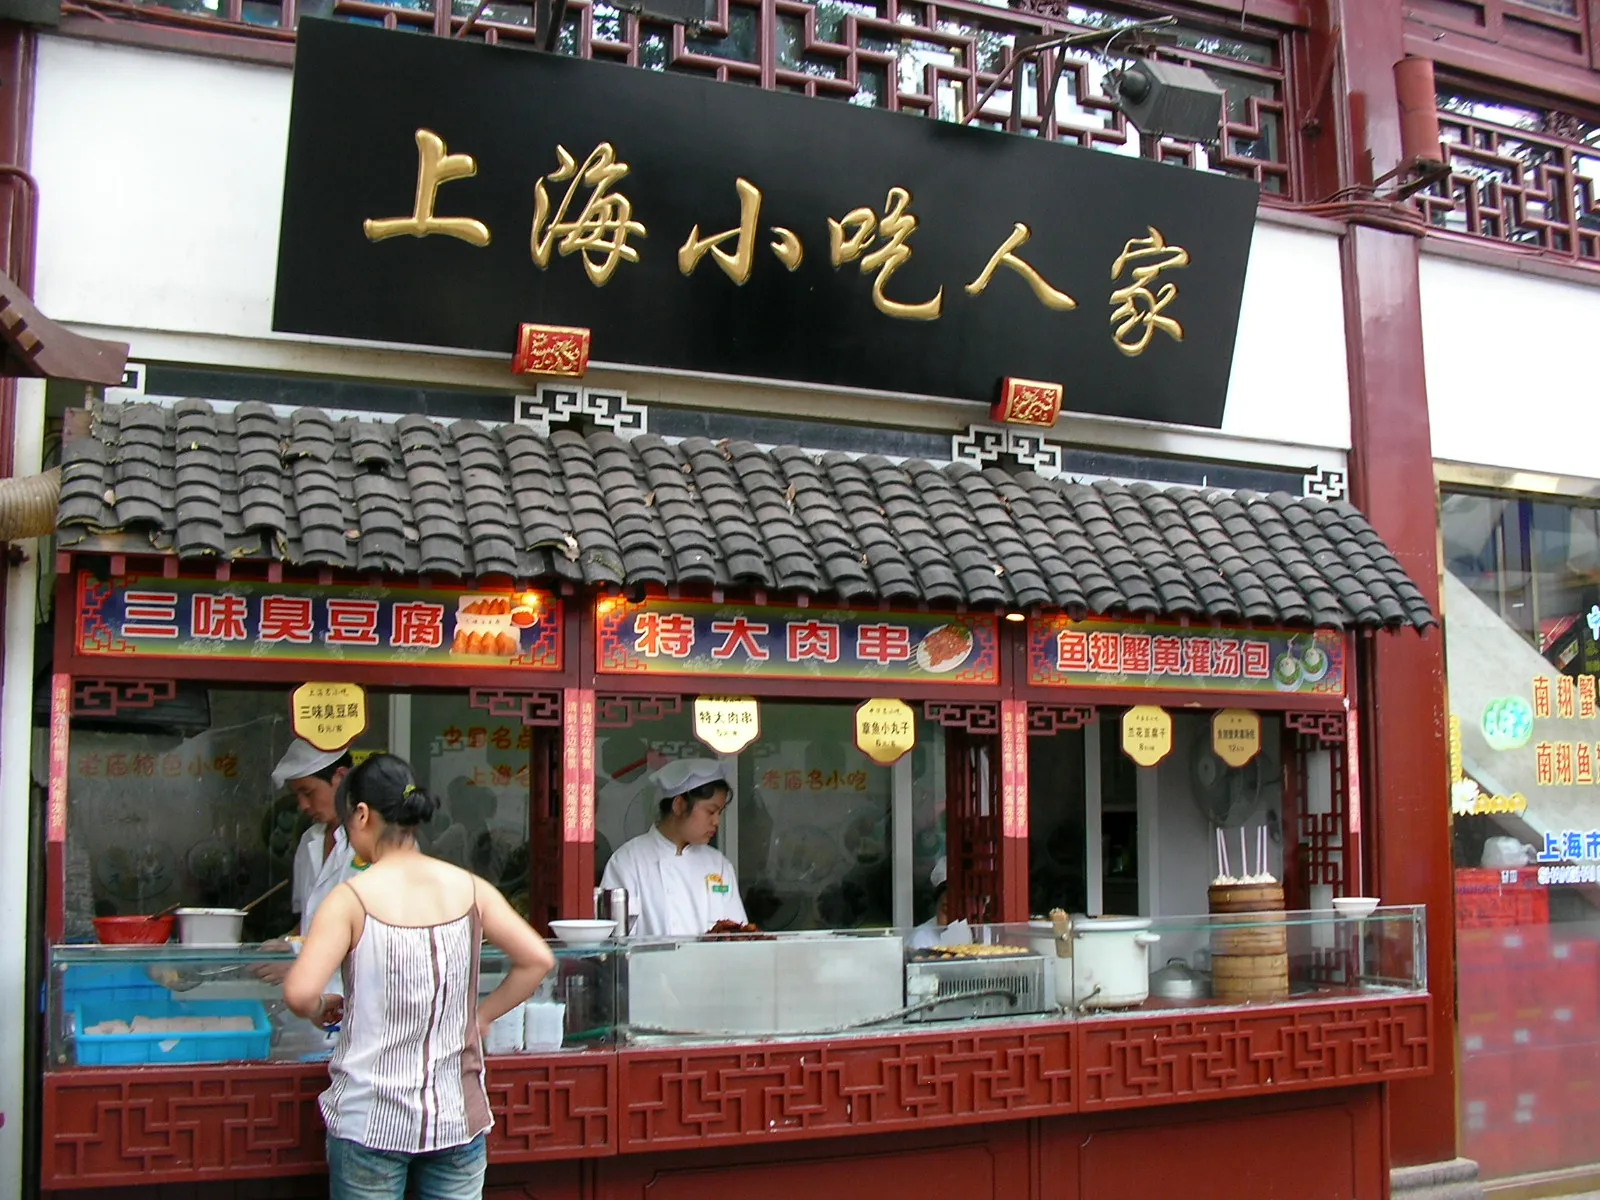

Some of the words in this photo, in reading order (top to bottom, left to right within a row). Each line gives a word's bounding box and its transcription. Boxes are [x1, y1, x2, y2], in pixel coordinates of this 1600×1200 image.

[363, 127, 1191, 358] 上海小吃人家
[121, 590, 445, 648] 三味臭豆腐
[634, 612, 910, 665] 特大肉串
[1057, 630, 1270, 679] 鱼翅蟹黄灌汤包
[299, 703, 360, 719] 三味臭豆腐
[699, 711, 753, 724] 特大肉串
[1536, 742, 1600, 785] 南翔鱼
